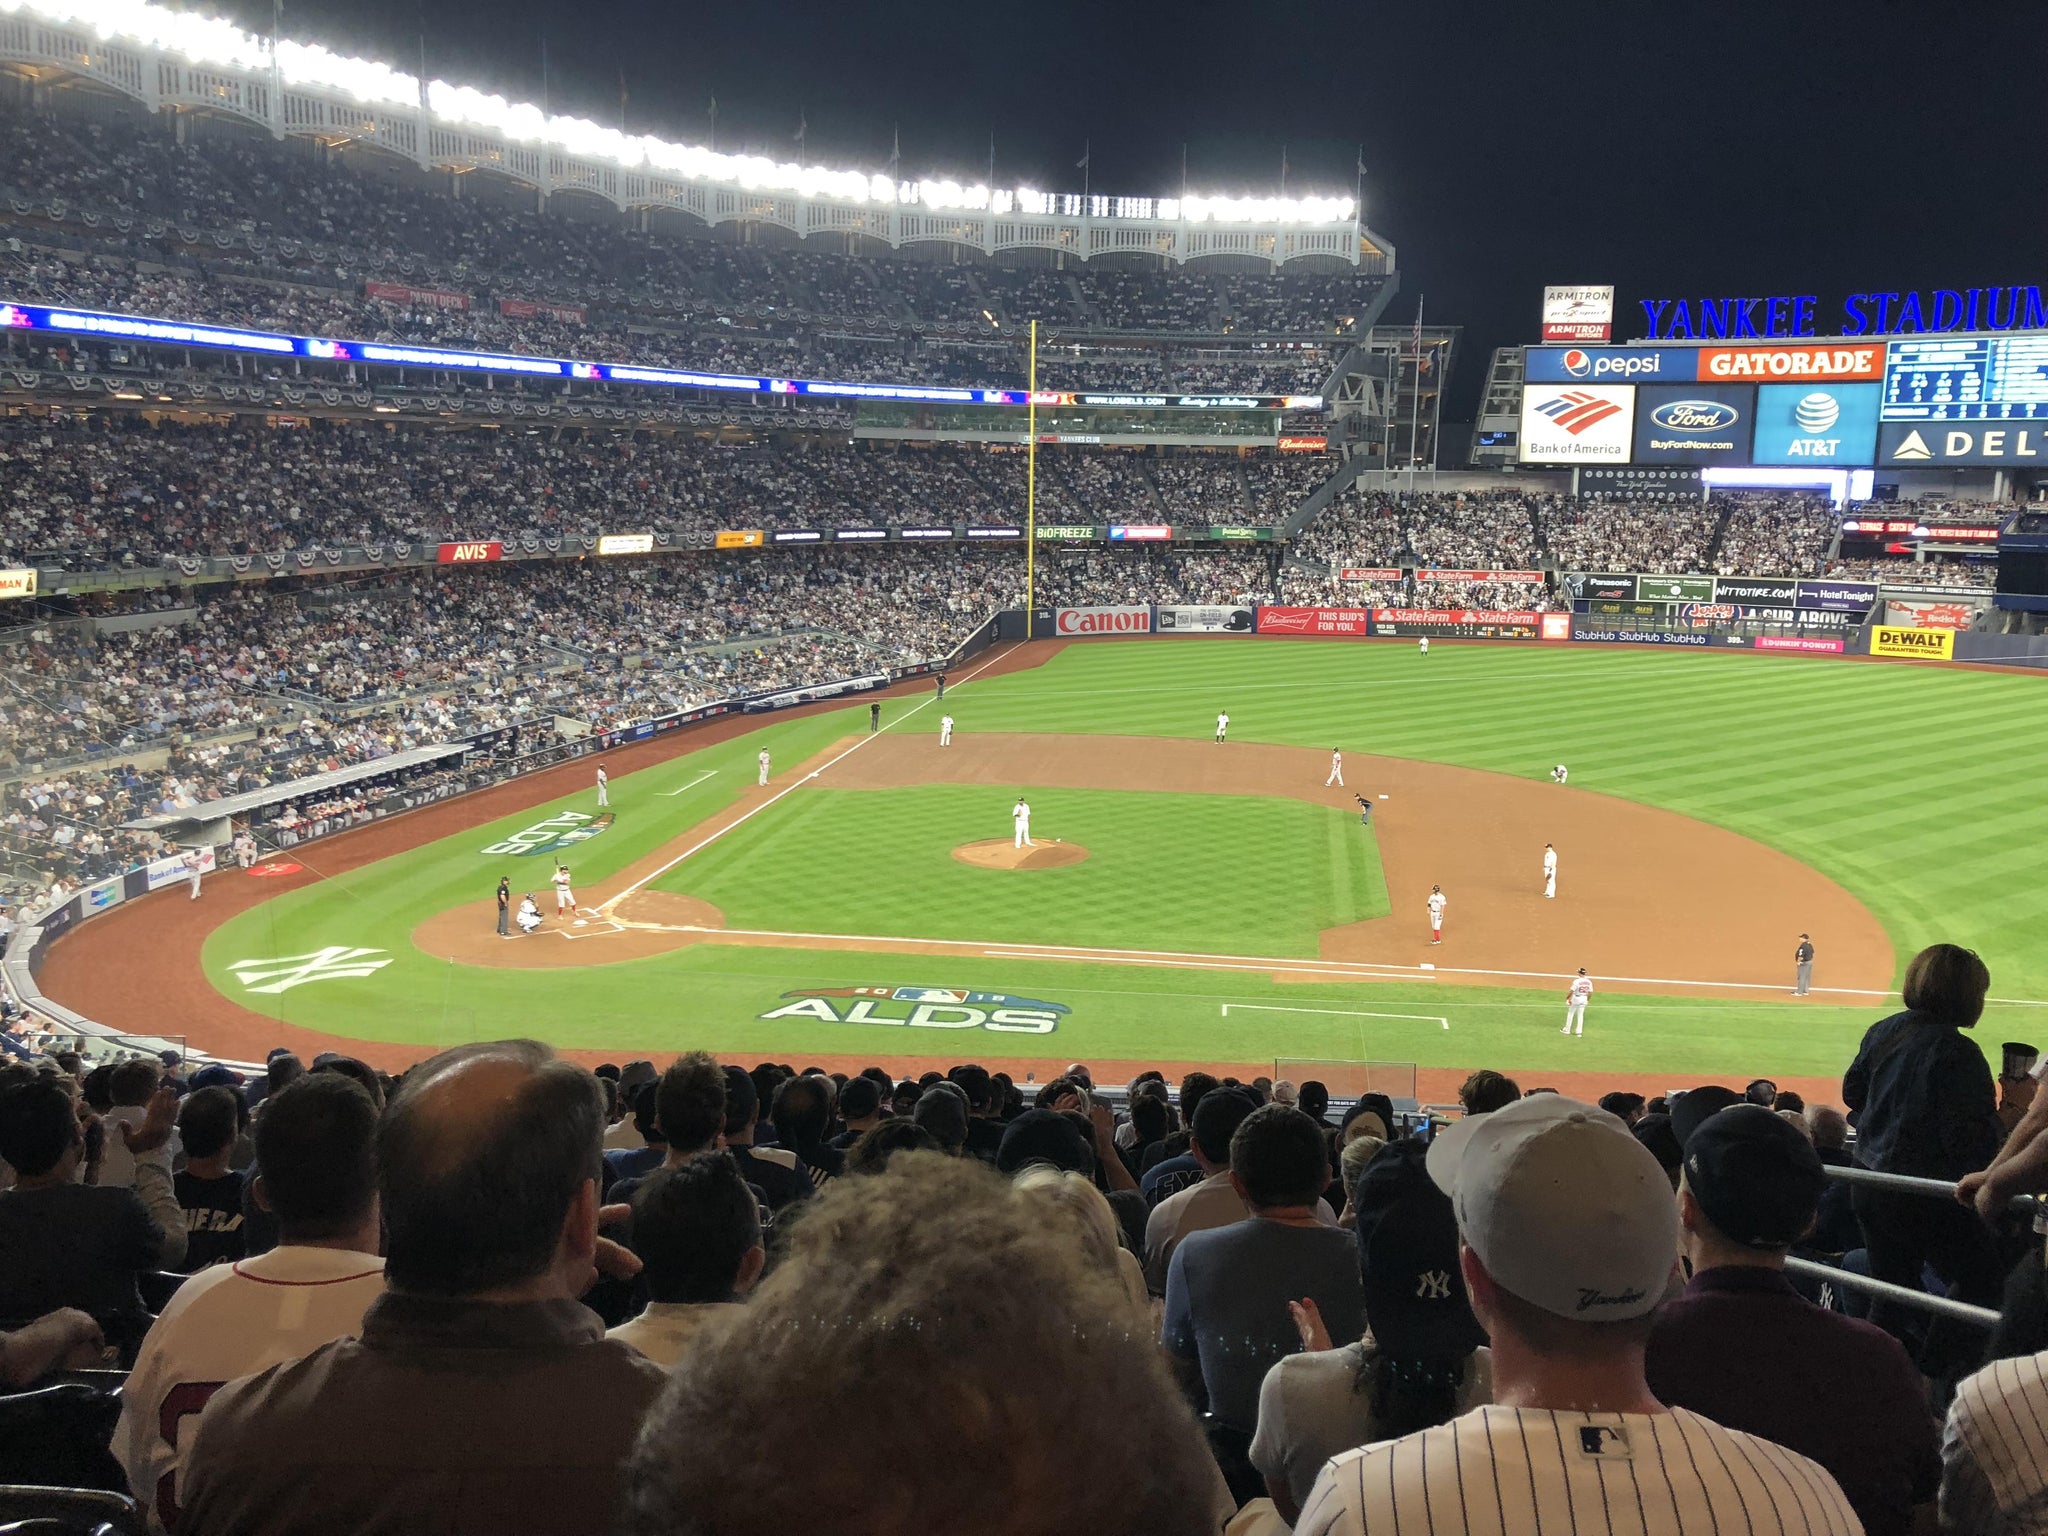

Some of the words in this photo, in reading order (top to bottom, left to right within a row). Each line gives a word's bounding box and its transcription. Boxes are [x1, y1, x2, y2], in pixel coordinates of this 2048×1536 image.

[1548, 291, 1610, 300] ARMITRON
[1639, 295, 1817, 339] YANKEE
[1841, 286, 2048, 336] STADIUM
[1547, 325, 1605, 333] ARMITRON
[1594, 353, 1660, 376] pepsi
[1710, 350, 1874, 375] GATORADE
[1667, 403, 1721, 427] Ford
[1279, 438, 1326, 449] Budweiser
[1530, 442, 1558, 454] Bank
[1560, 442, 1573, 454] of
[1573, 442, 1621, 455] America
[1650, 440, 1733, 450] BuyFordNow.com
[1787, 439, 1841, 457] AT&T
[453, 544, 488, 560] AVIS
[1590, 578, 1632, 587] Panasonic
[1716, 585, 1795, 600] NITTOTIRE.COM
[1689, 603, 1734, 617] Jersey
[1058, 610, 1149, 633] Canon
[1318, 612, 1338, 621] THIS
[1339, 612, 1365, 621] BUD'S
[1318, 622, 1336, 631] FOR
[1337, 622, 1356, 631] YOU.
[1575, 631, 1615, 641] StubHub
[1619, 632, 1660, 642] StubHub
[1663, 633, 1705, 644] StubHub
[1802, 641, 1836, 650] DONUTS
[1878, 646, 1919, 654] GUARANTEED
[149, 871, 164, 883] Bank
[759, 998, 1057, 1034] ALDS
